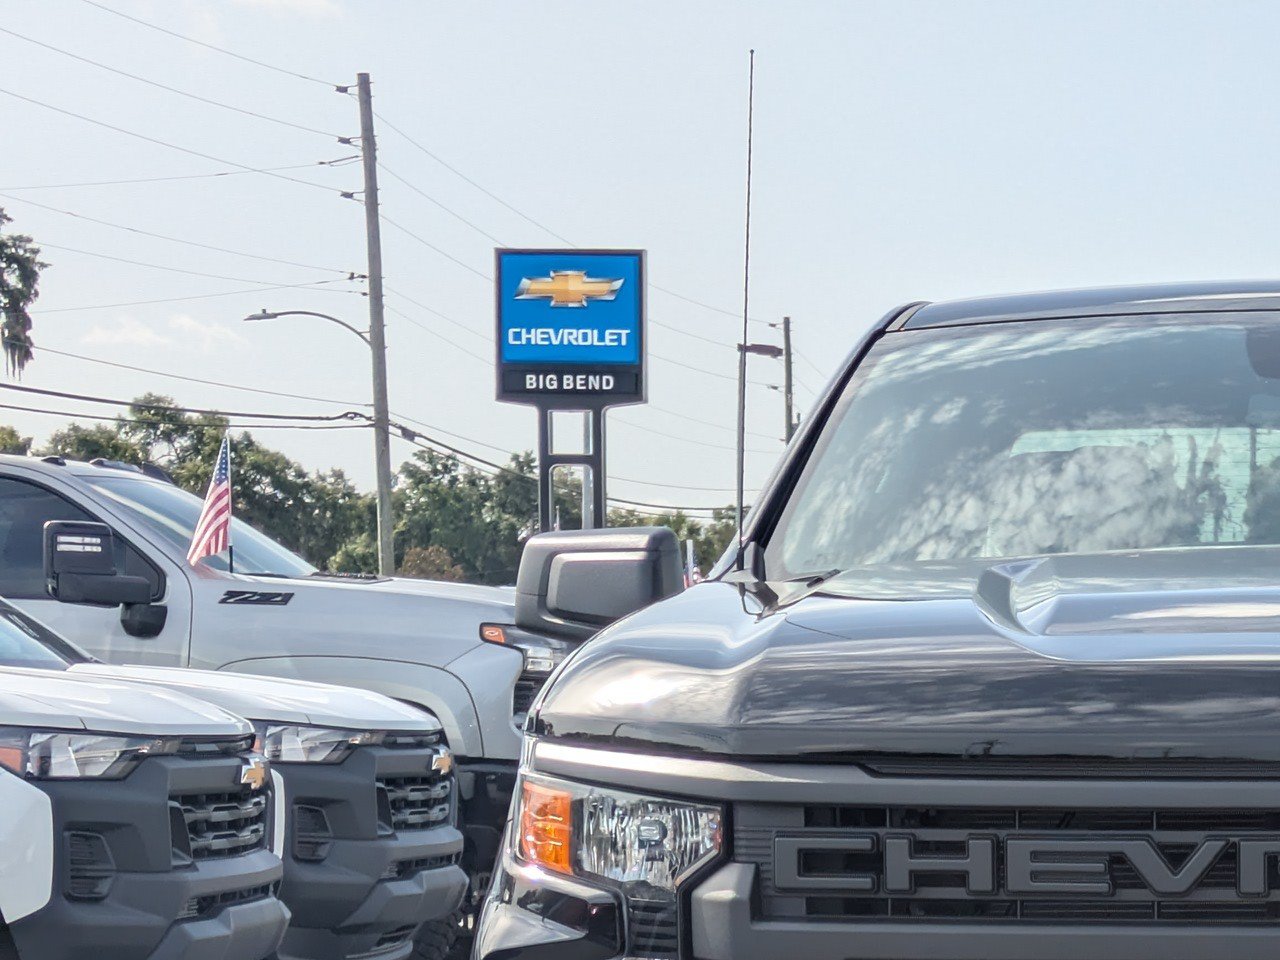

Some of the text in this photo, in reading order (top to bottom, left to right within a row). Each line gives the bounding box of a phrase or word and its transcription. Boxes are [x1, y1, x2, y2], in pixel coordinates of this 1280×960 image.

[508, 328, 630, 346] CHEVROLET
[525, 374, 614, 390] BIG BEND
